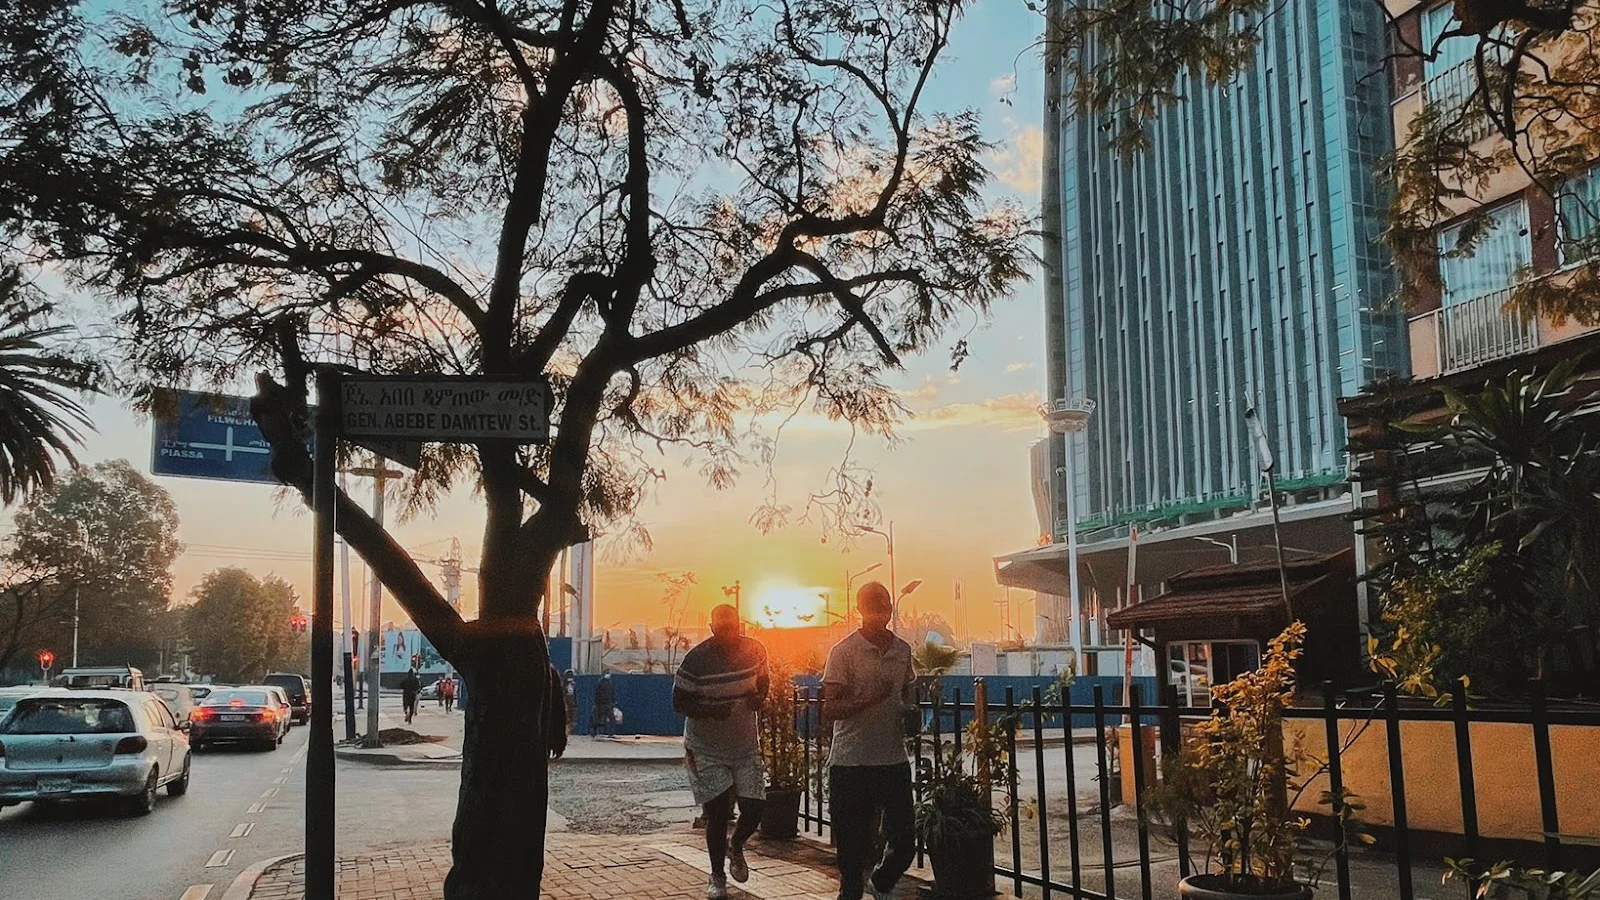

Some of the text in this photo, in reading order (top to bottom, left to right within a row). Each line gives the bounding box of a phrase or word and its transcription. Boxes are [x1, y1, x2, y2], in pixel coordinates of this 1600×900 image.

[379, 386, 415, 406] አበበ
[347, 412, 542, 431] GEN. ABEBE DAMTEW St.
[160, 448, 204, 459] PIASSA
